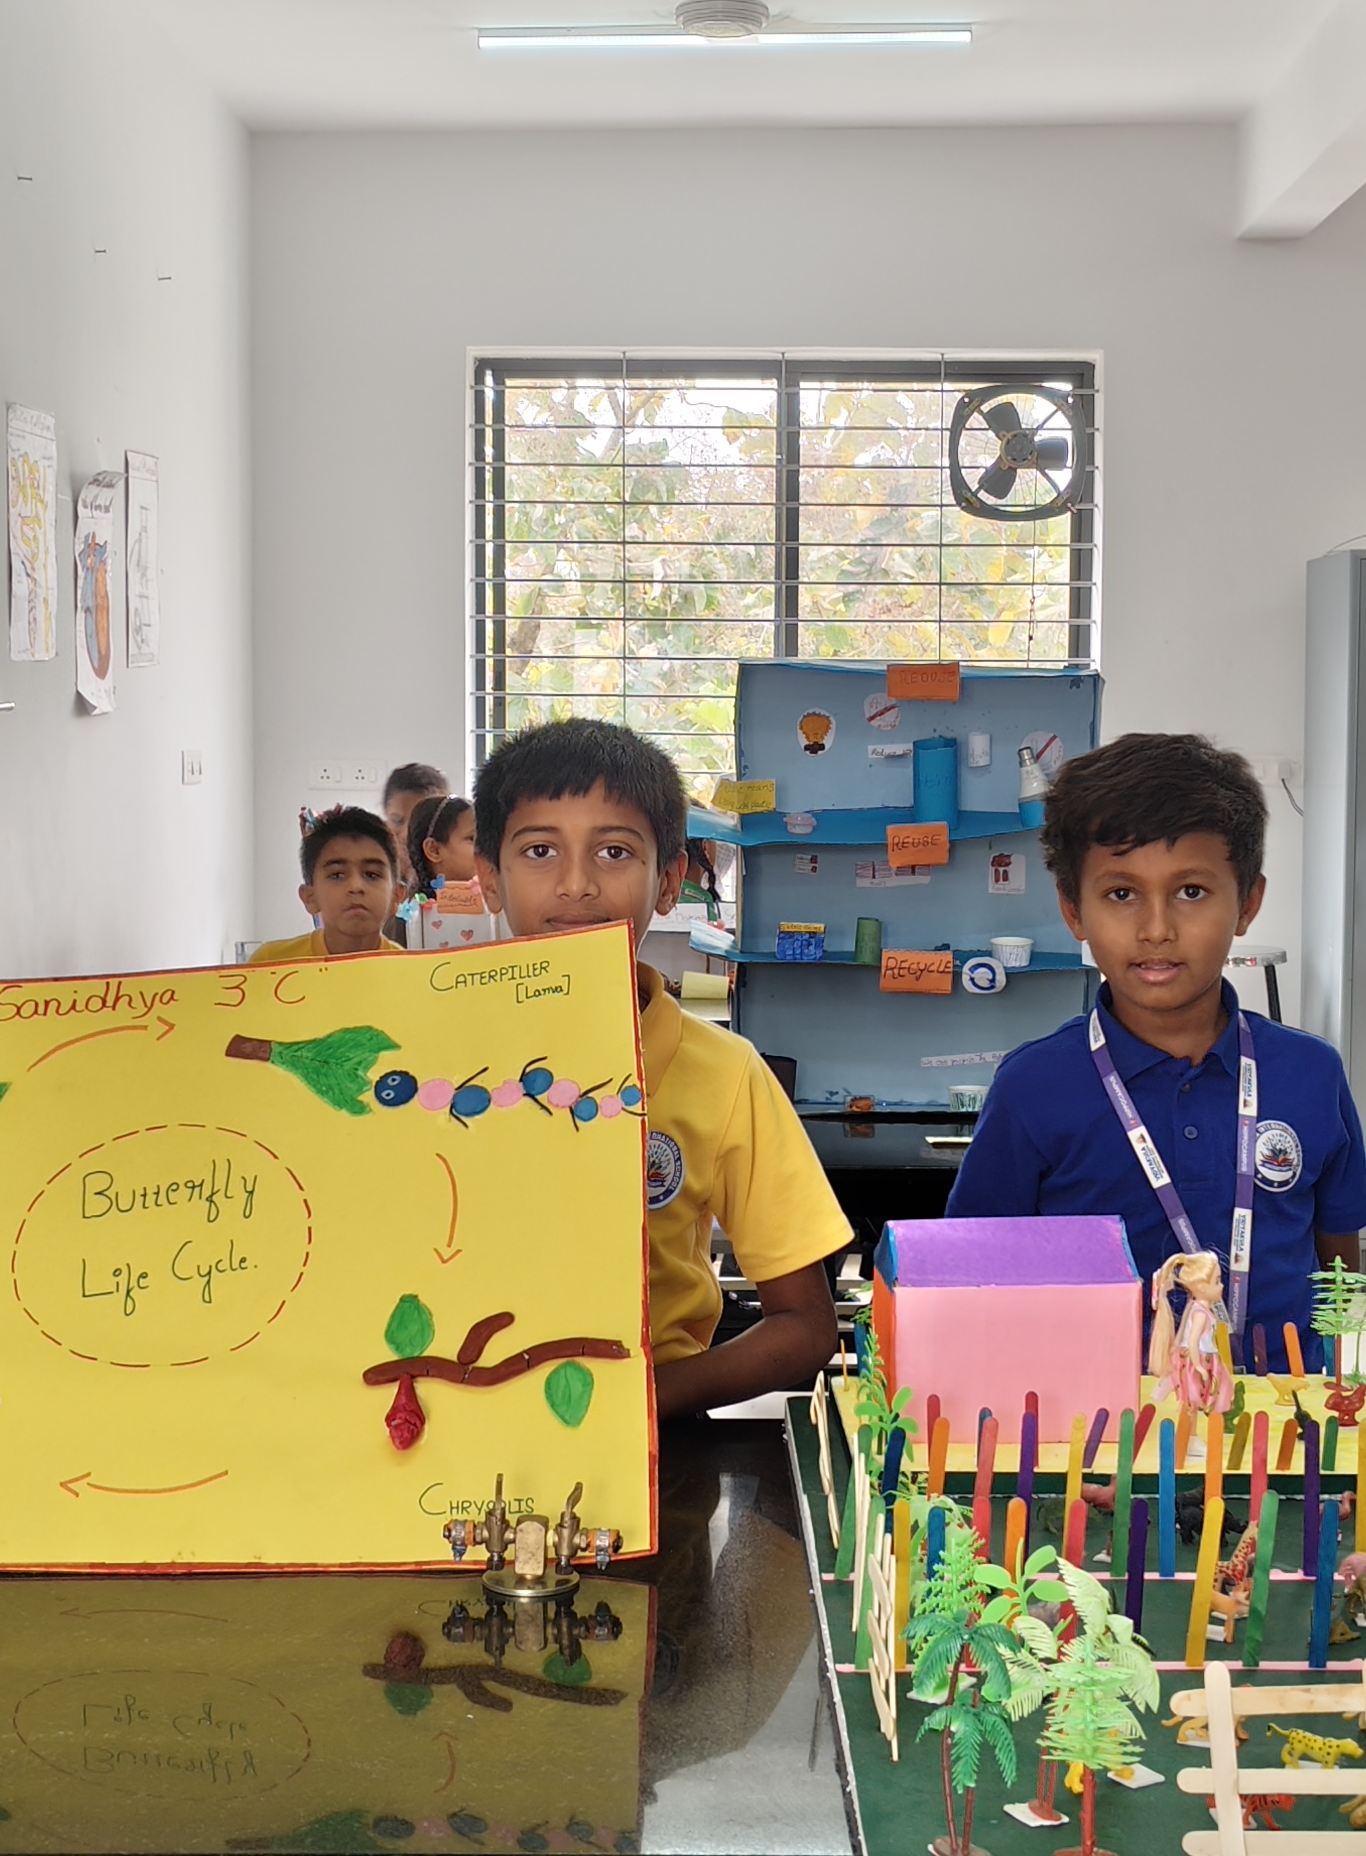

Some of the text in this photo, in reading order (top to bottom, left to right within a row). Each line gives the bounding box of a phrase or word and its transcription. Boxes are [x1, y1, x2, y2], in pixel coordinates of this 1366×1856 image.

[891, 833, 941, 852] REUSE
[430, 960, 550, 992] CATERPILLER
[884, 957, 953, 981] RECYCLE
[214, 973, 248, 1008] 3
[81, 1158, 258, 1223] Butterfly
[81, 1258, 150, 1317] Life
